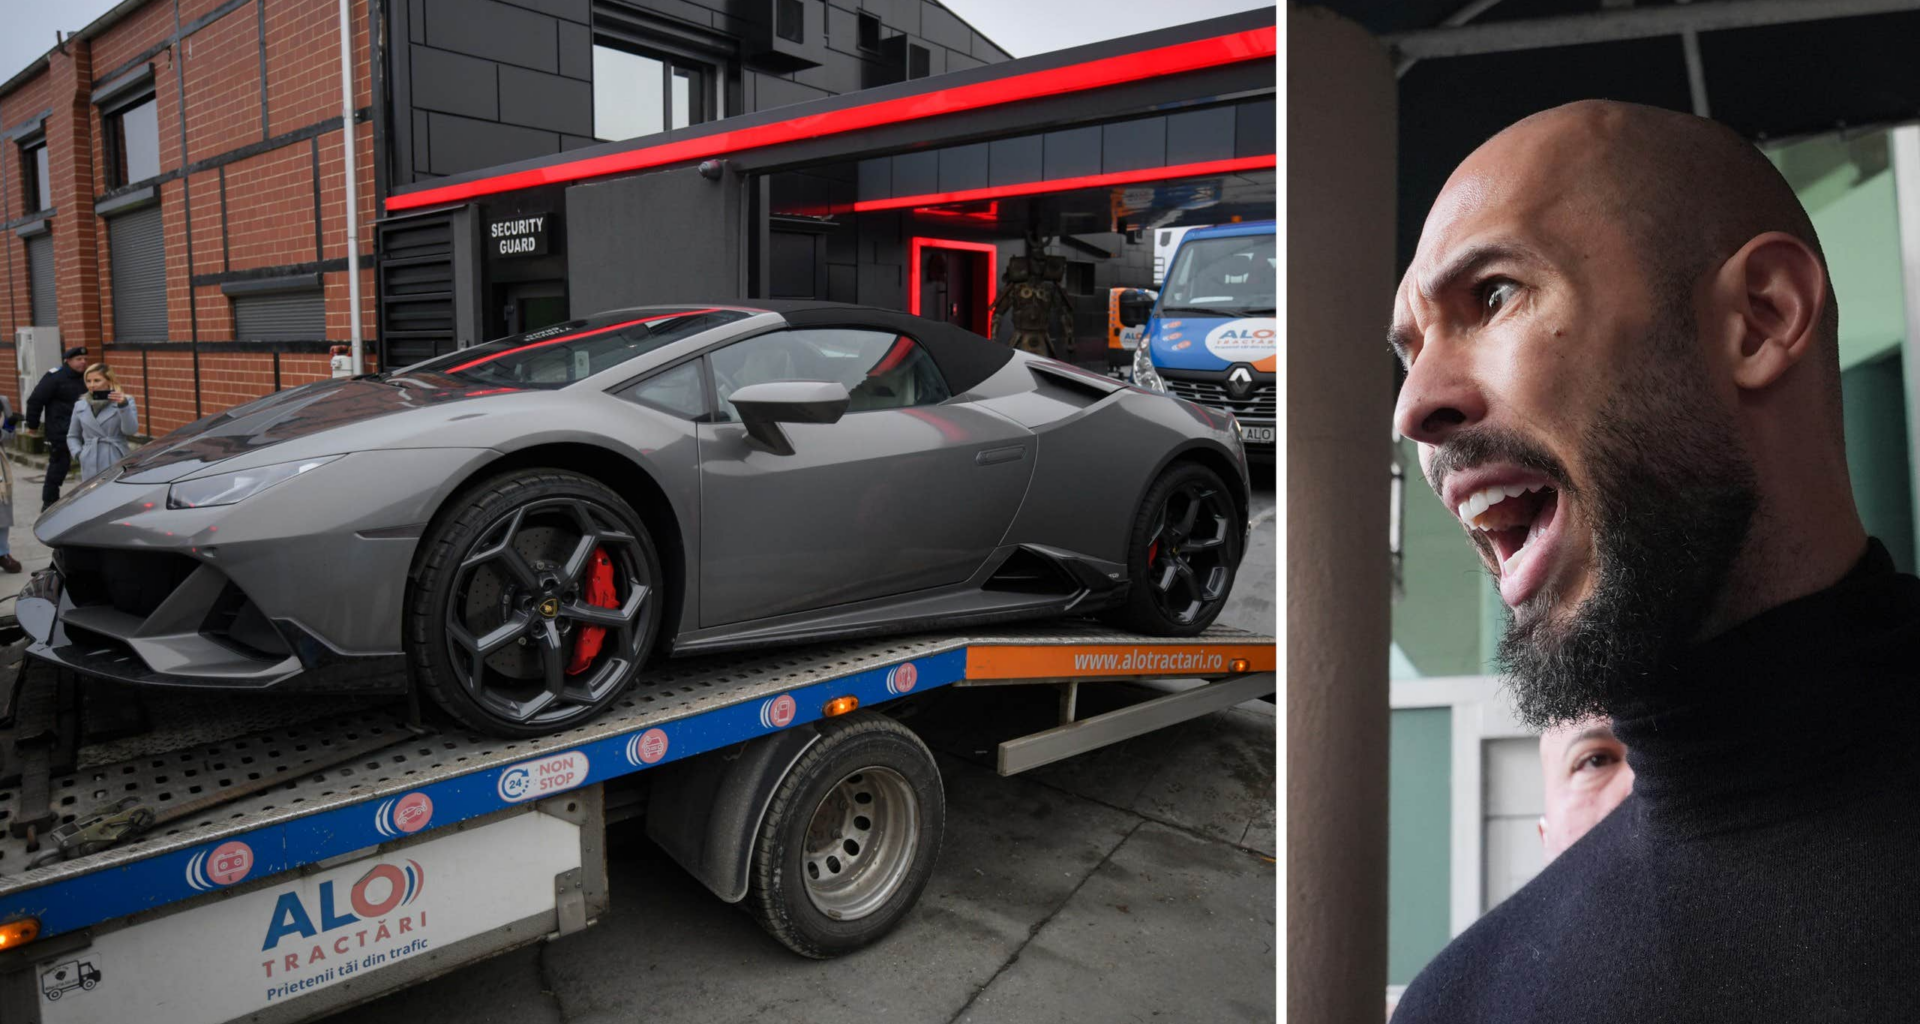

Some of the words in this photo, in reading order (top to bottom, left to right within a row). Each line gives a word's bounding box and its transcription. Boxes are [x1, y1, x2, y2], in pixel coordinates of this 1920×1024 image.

[491, 217, 543, 238] SECURITY
[499, 237, 536, 254] GUARD
[1219, 329, 1275, 339] ALO
[1074, 649, 1222, 671] www.alotractari.ro
[540, 757, 574, 776] NON
[509, 779, 522, 789] 24
[540, 772, 574, 790] STOP
[261, 863, 406, 952] ALO
[262, 911, 427, 978] TRACTĂRI
[266, 968, 335, 1000] Prietenii
[338, 960, 358, 976] tăi
[362, 952, 386, 969] din
[389, 938, 428, 959] trafic
